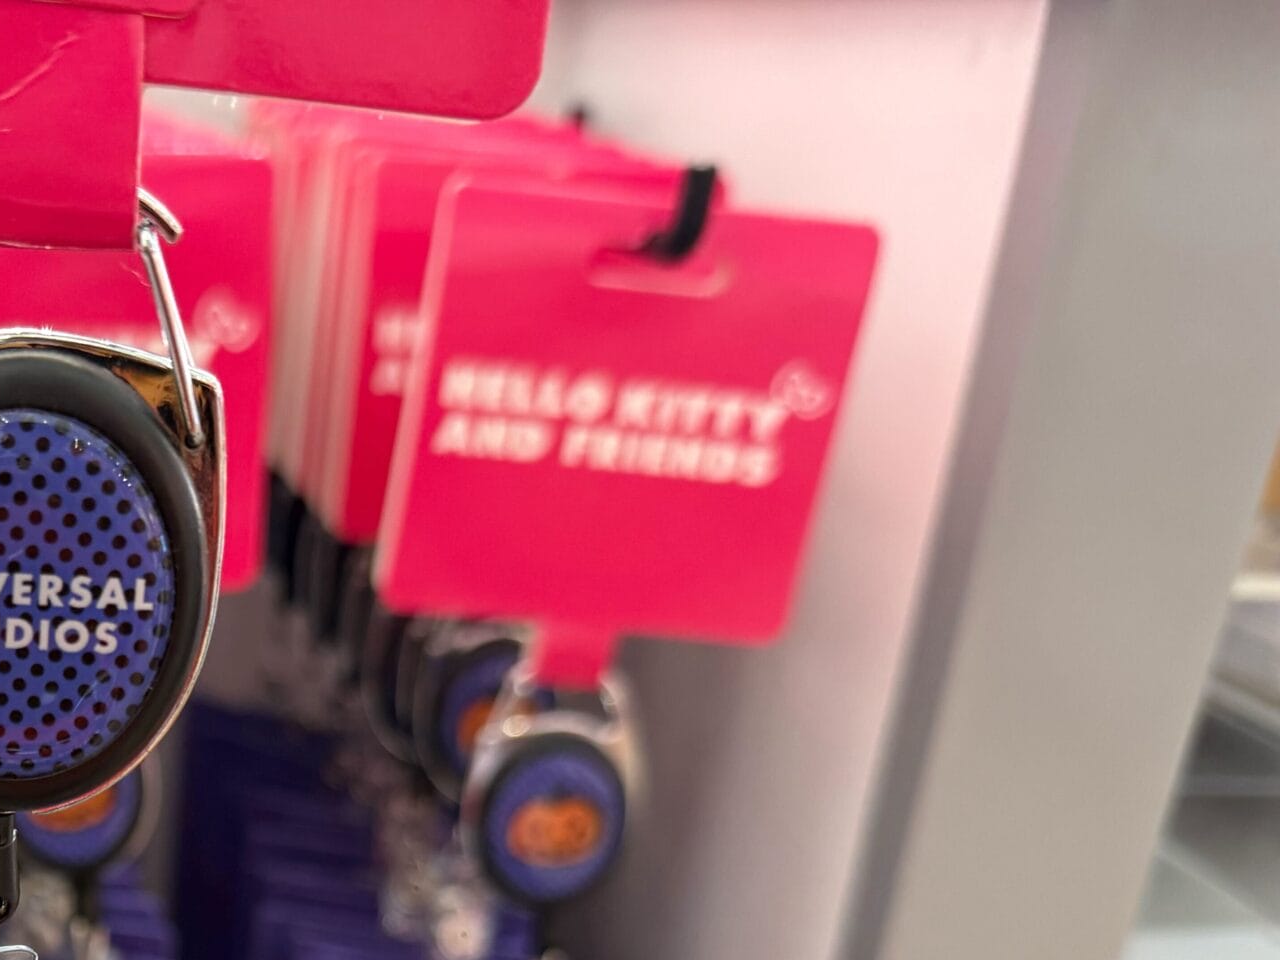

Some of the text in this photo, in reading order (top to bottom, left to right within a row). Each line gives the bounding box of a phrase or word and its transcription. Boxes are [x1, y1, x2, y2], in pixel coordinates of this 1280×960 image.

[439, 362, 790, 441] HELLO KITTY
[431, 411, 778, 487] AND FRIENDS
